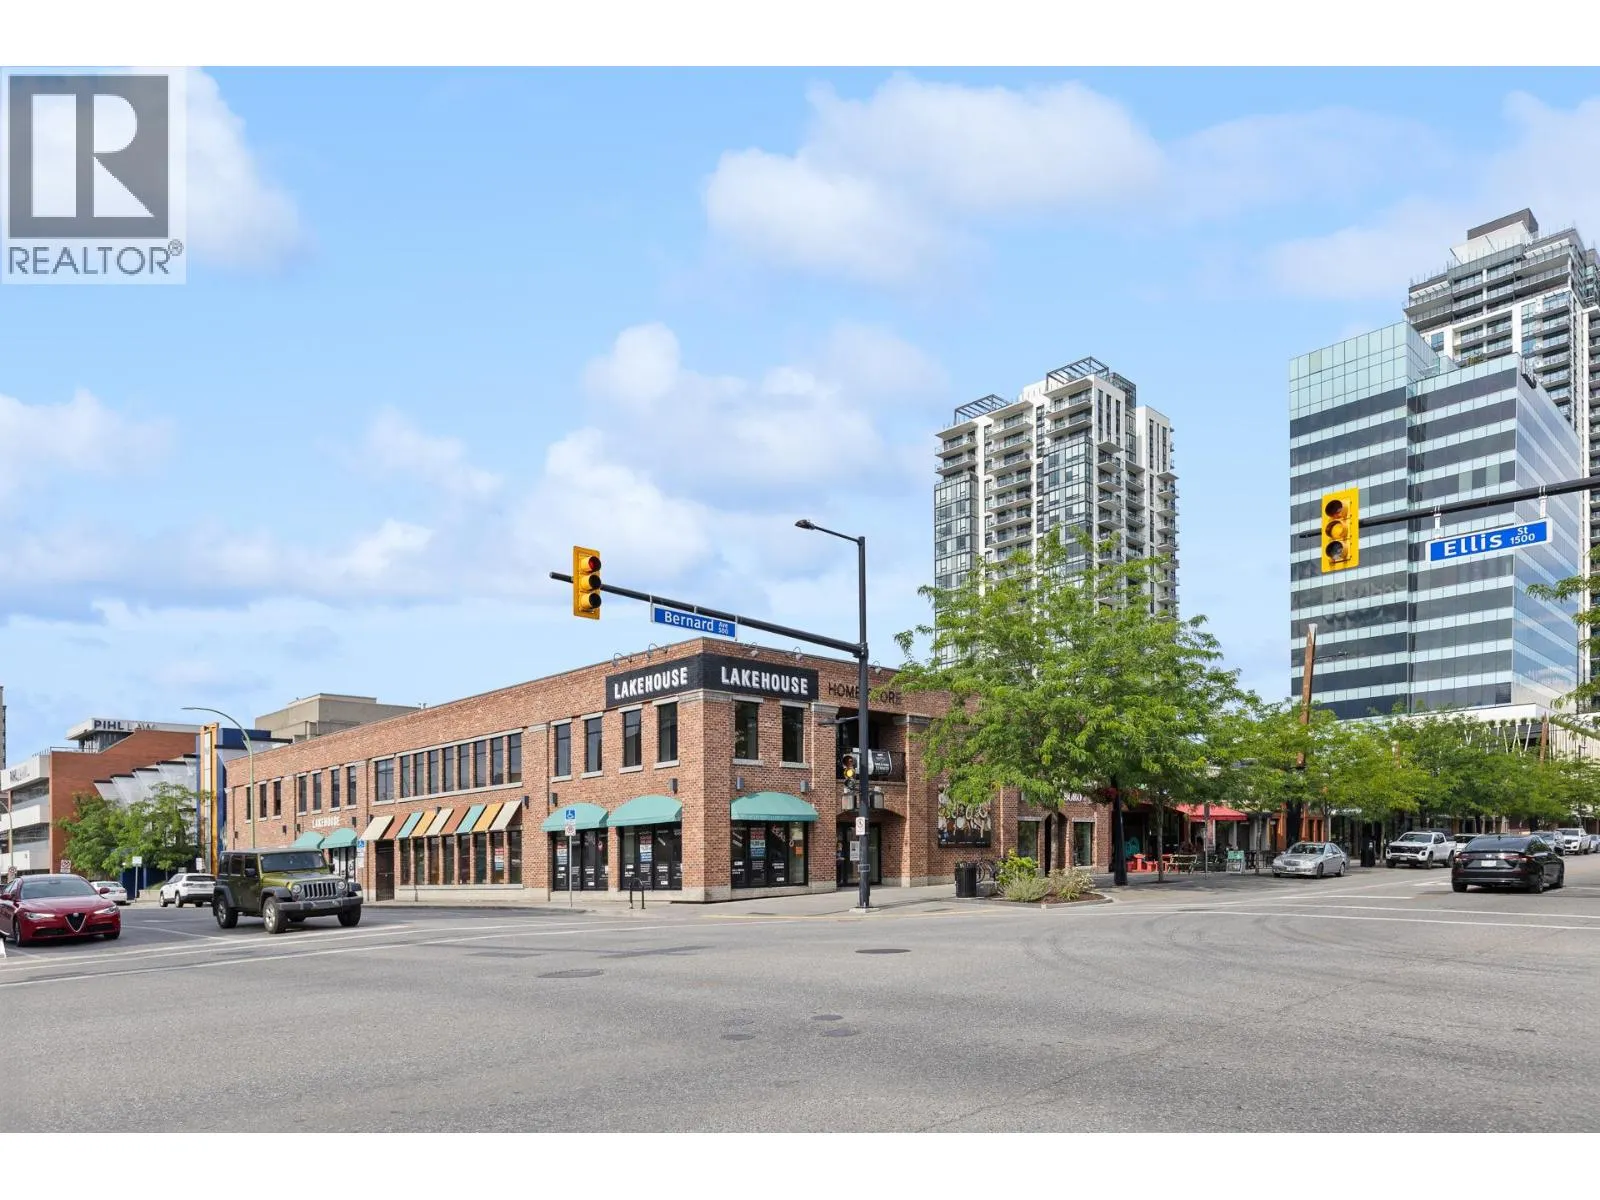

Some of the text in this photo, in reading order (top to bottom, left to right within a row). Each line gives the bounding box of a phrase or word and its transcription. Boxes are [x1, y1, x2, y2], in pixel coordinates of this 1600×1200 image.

[1510, 532, 1536, 545] 1500
[1517, 526, 1529, 536] St
[1443, 533, 1503, 557] Ellis
[664, 610, 714, 632] Bernard
[718, 621, 729, 630] Ave
[614, 666, 688, 700] LAKEHOUSE
[721, 666, 809, 696] LAKEHOUSE
[94, 720, 125, 731] PIHL
